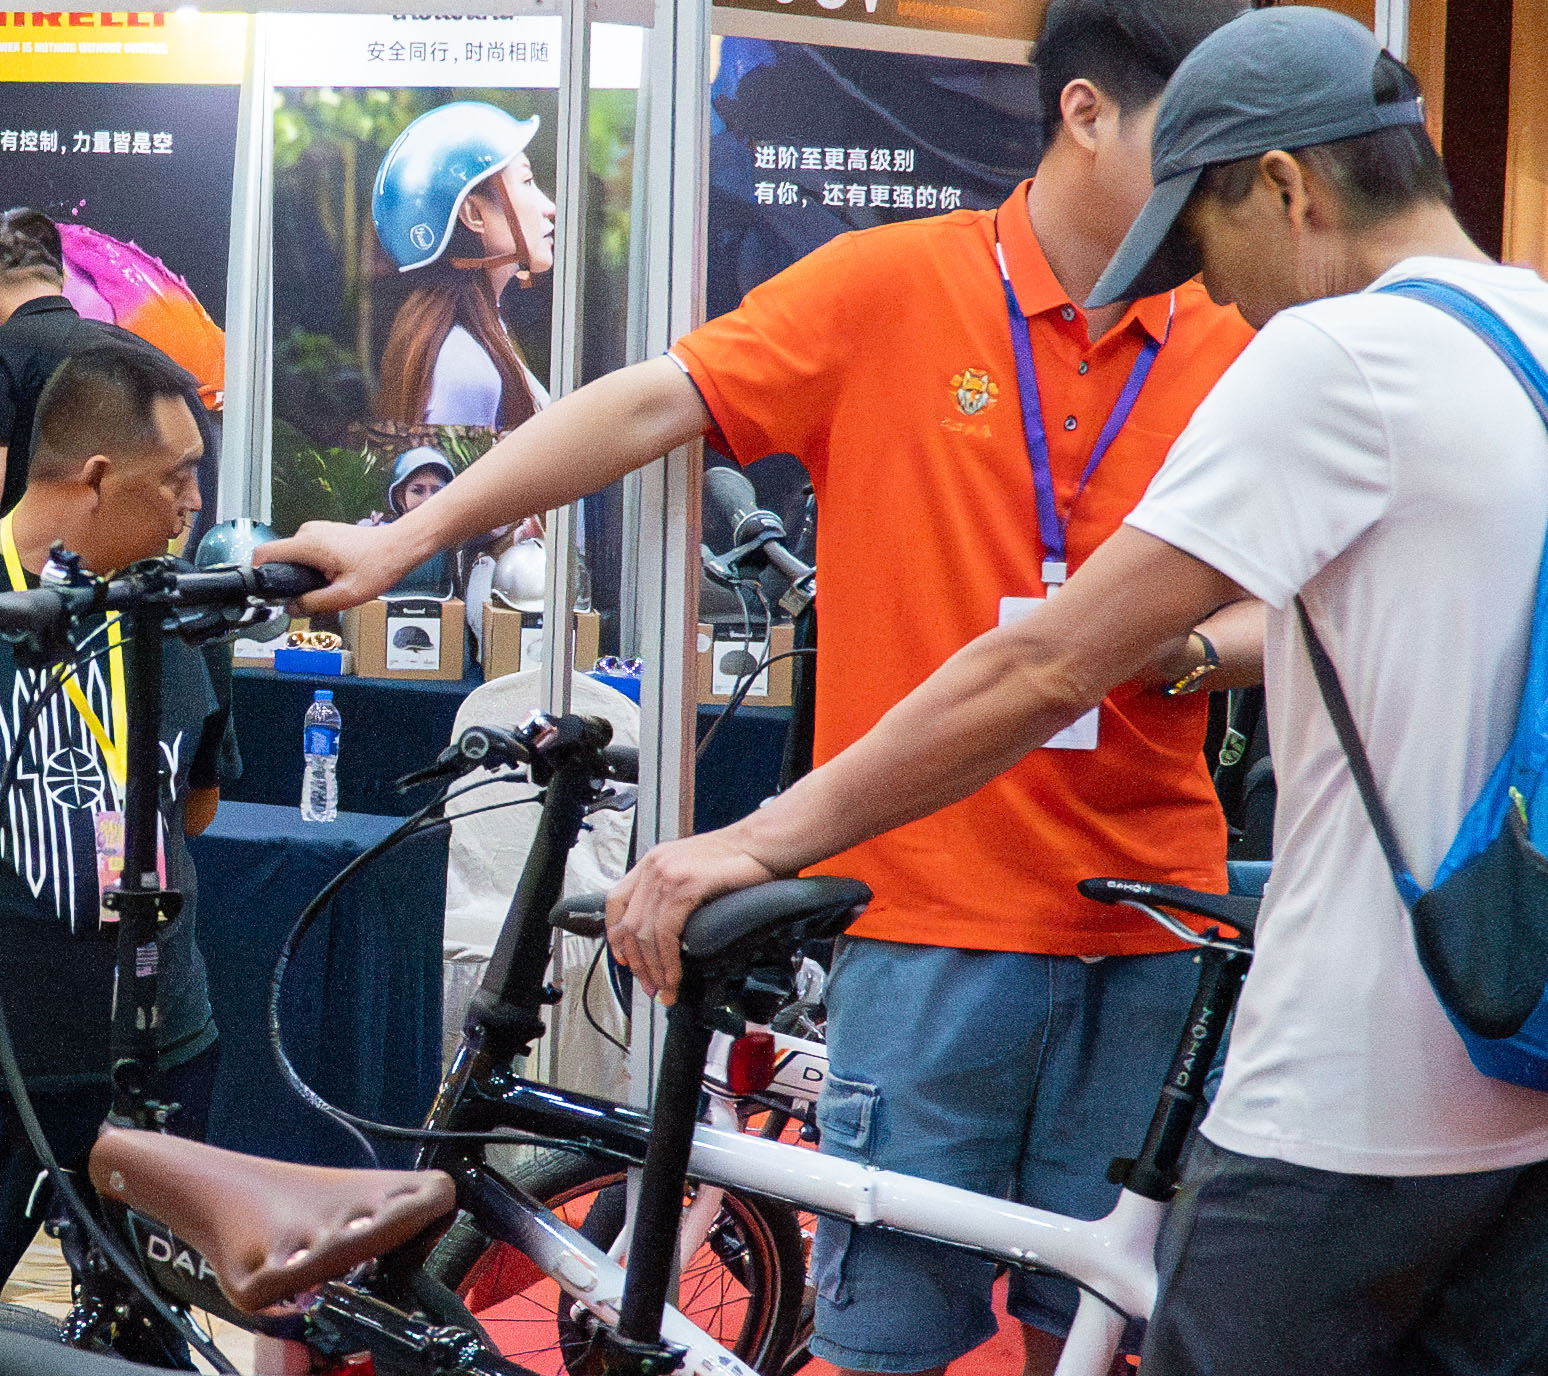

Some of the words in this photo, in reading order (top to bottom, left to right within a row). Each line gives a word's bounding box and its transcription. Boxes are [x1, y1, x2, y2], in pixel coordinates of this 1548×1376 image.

[754, 146, 915, 172] 进阶至更高级别
